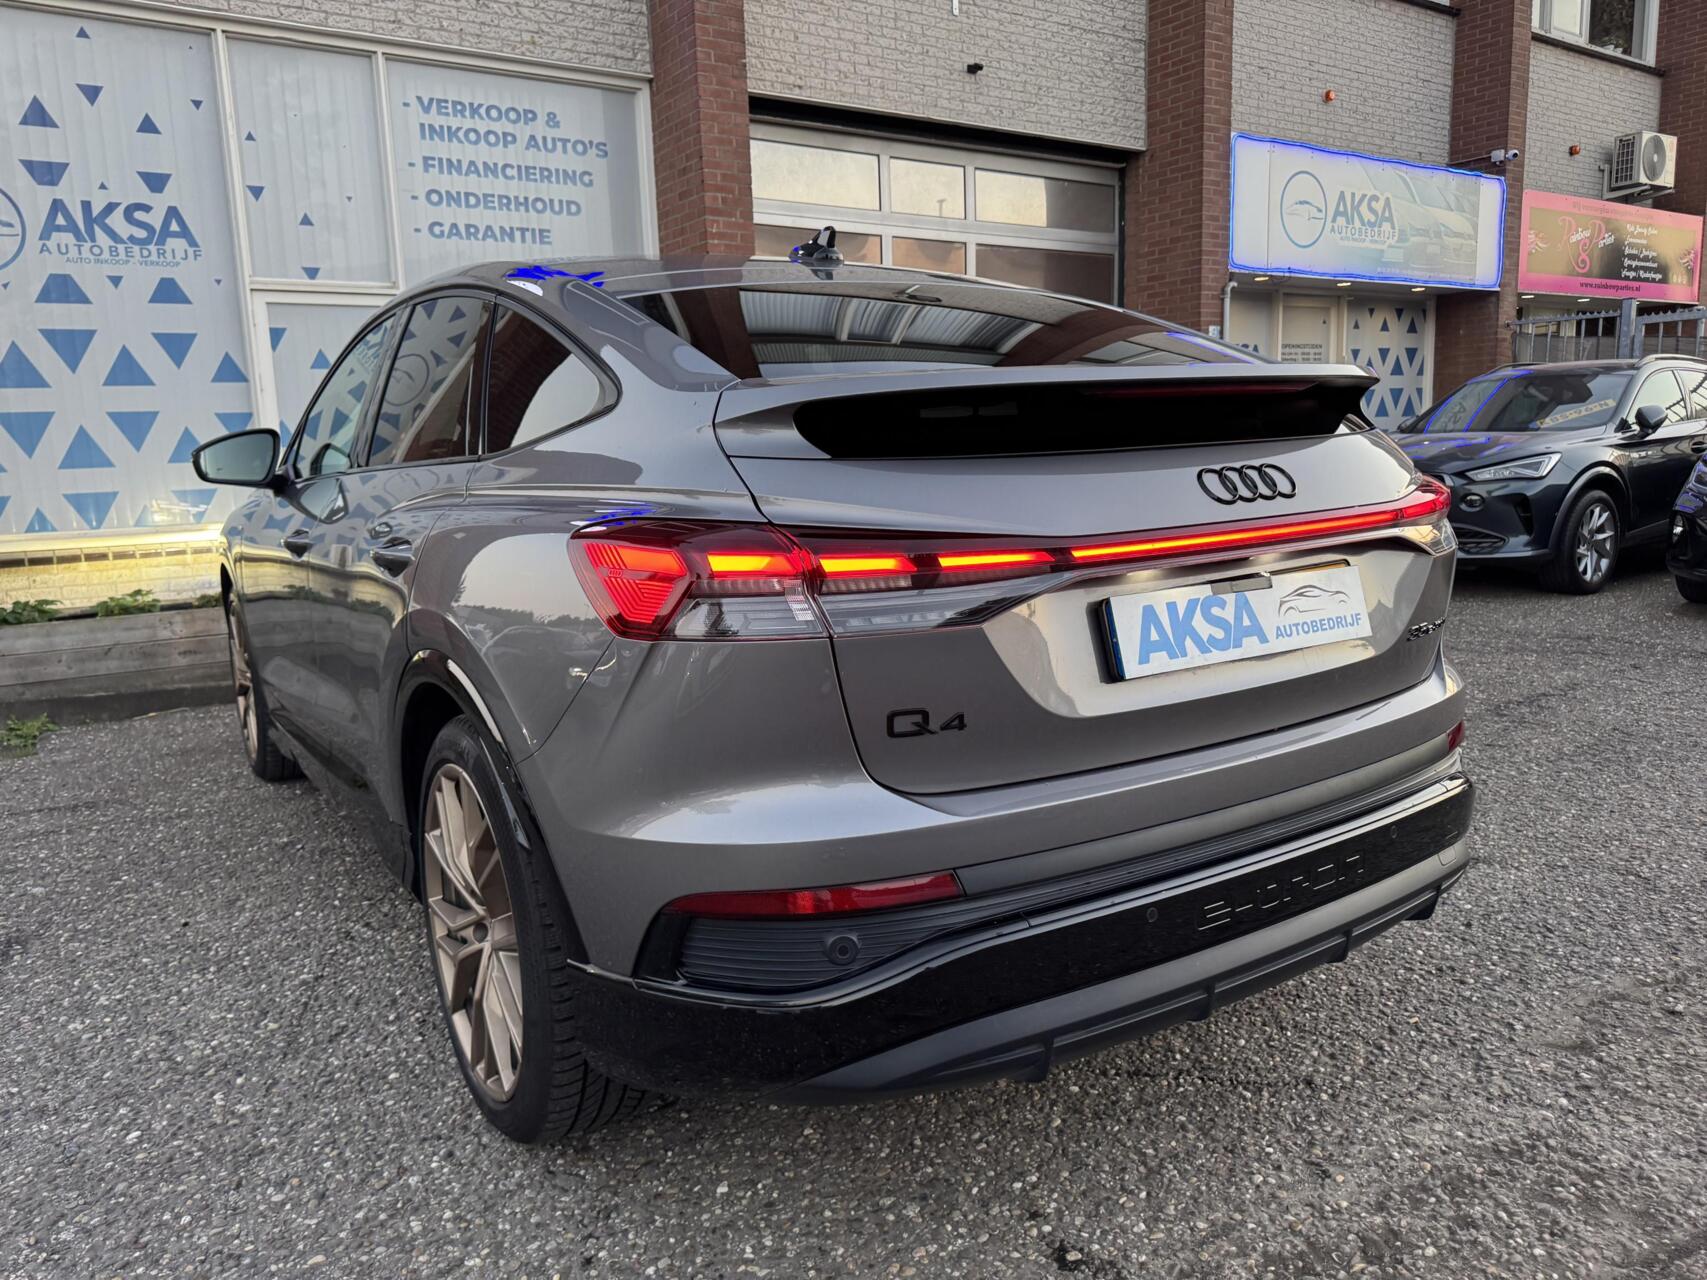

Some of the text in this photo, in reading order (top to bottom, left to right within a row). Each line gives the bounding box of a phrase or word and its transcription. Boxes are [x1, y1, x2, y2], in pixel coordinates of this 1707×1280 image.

[416, 96, 538, 126] VERKOOP
[545, 112, 561, 129] &
[419, 122, 609, 159] INKOOP AUTO'S
[422, 155, 594, 188] FINANCIERING
[425, 189, 582, 217] ONDERHOUD
[1331, 190, 1397, 230] AKSA
[38, 198, 201, 248] AKSA
[428, 221, 553, 246] GARANTIE
[1330, 224, 1397, 241] AUTOBEDRIJF
[39, 242, 203, 261] AUTOBEDRIJF
[65, 256, 92, 265] AUTO
[93, 257, 131, 266] INKOOP
[139, 259, 181, 268] VERKOOP
[1138, 592, 1362, 665] AKSA AUTOBEDRIJF
[886, 708, 967, 738] Q4
